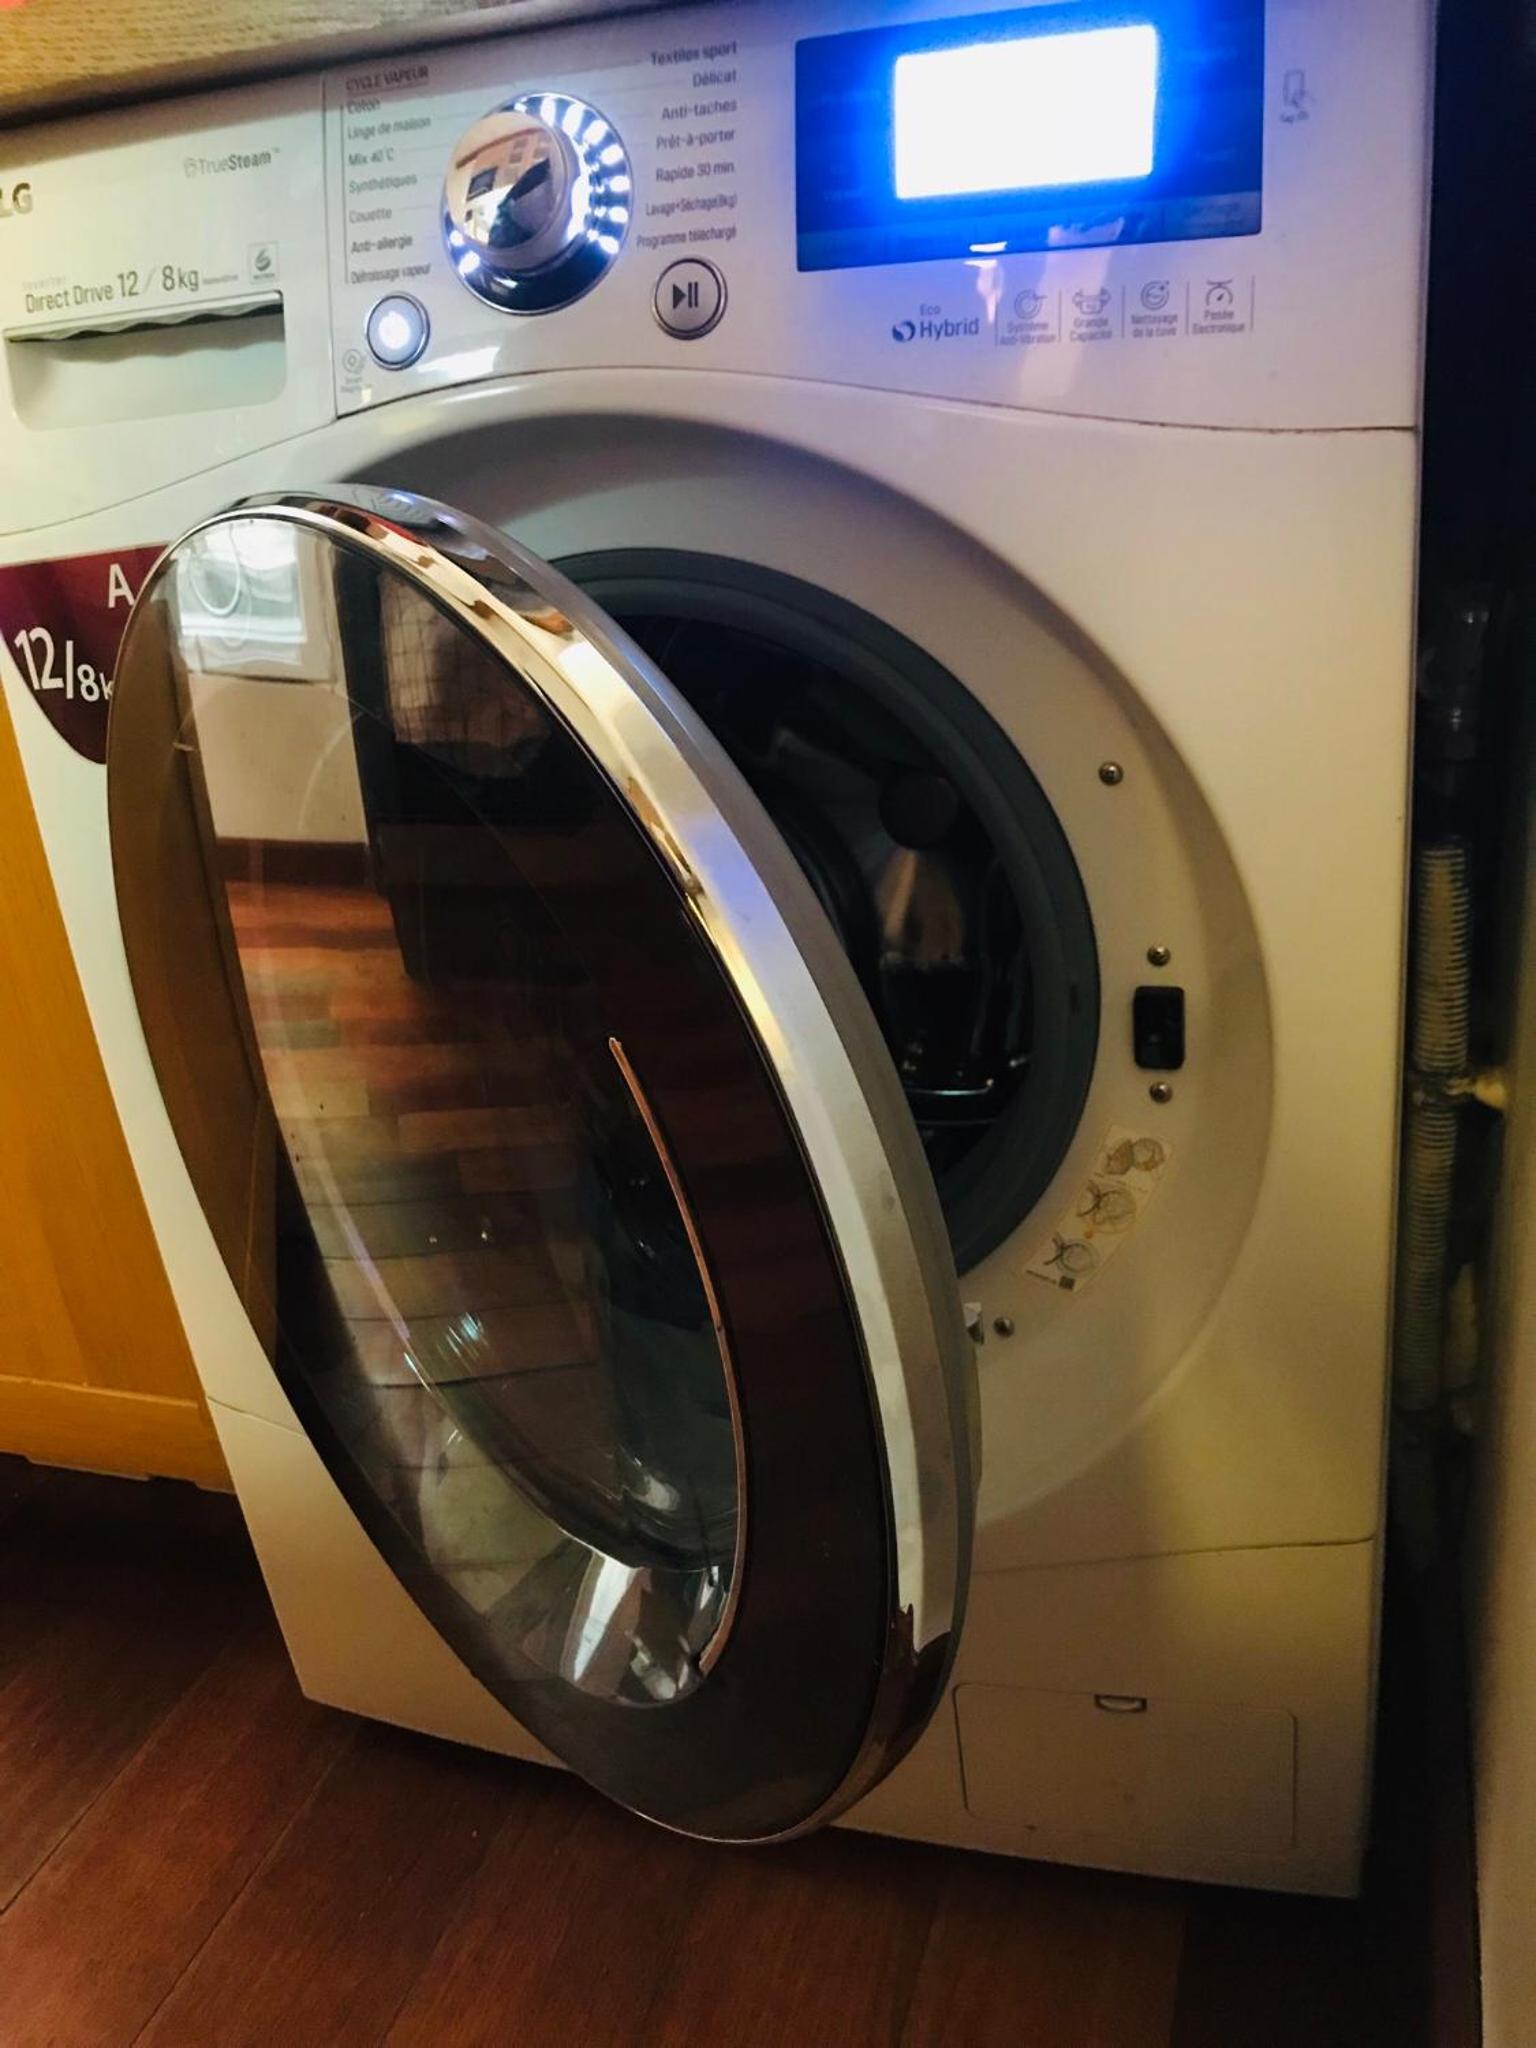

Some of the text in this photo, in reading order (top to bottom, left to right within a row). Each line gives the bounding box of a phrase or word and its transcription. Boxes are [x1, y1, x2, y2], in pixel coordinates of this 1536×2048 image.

[651, 41, 737, 66] Textiles sport
[345, 65, 429, 91] CYCLE VAPEUR
[692, 69, 737, 88] Délicat
[662, 100, 737, 120] Anti-taches
[348, 125, 376, 141] Linge
[378, 122, 391, 134] de
[348, 152, 368, 167] Mix
[656, 161, 735, 184] Rapide 30 min
[351, 234, 413, 254] Anti-allergie
[636, 232, 687, 249] Programme
[402, 263, 431, 277] vapeur
[25, 290, 70, 313] Direct
[73, 281, 114, 305] Drive
[117, 270, 140, 298] 12
[920, 304, 941, 316] Eco
[920, 317, 980, 341] Hybrid
